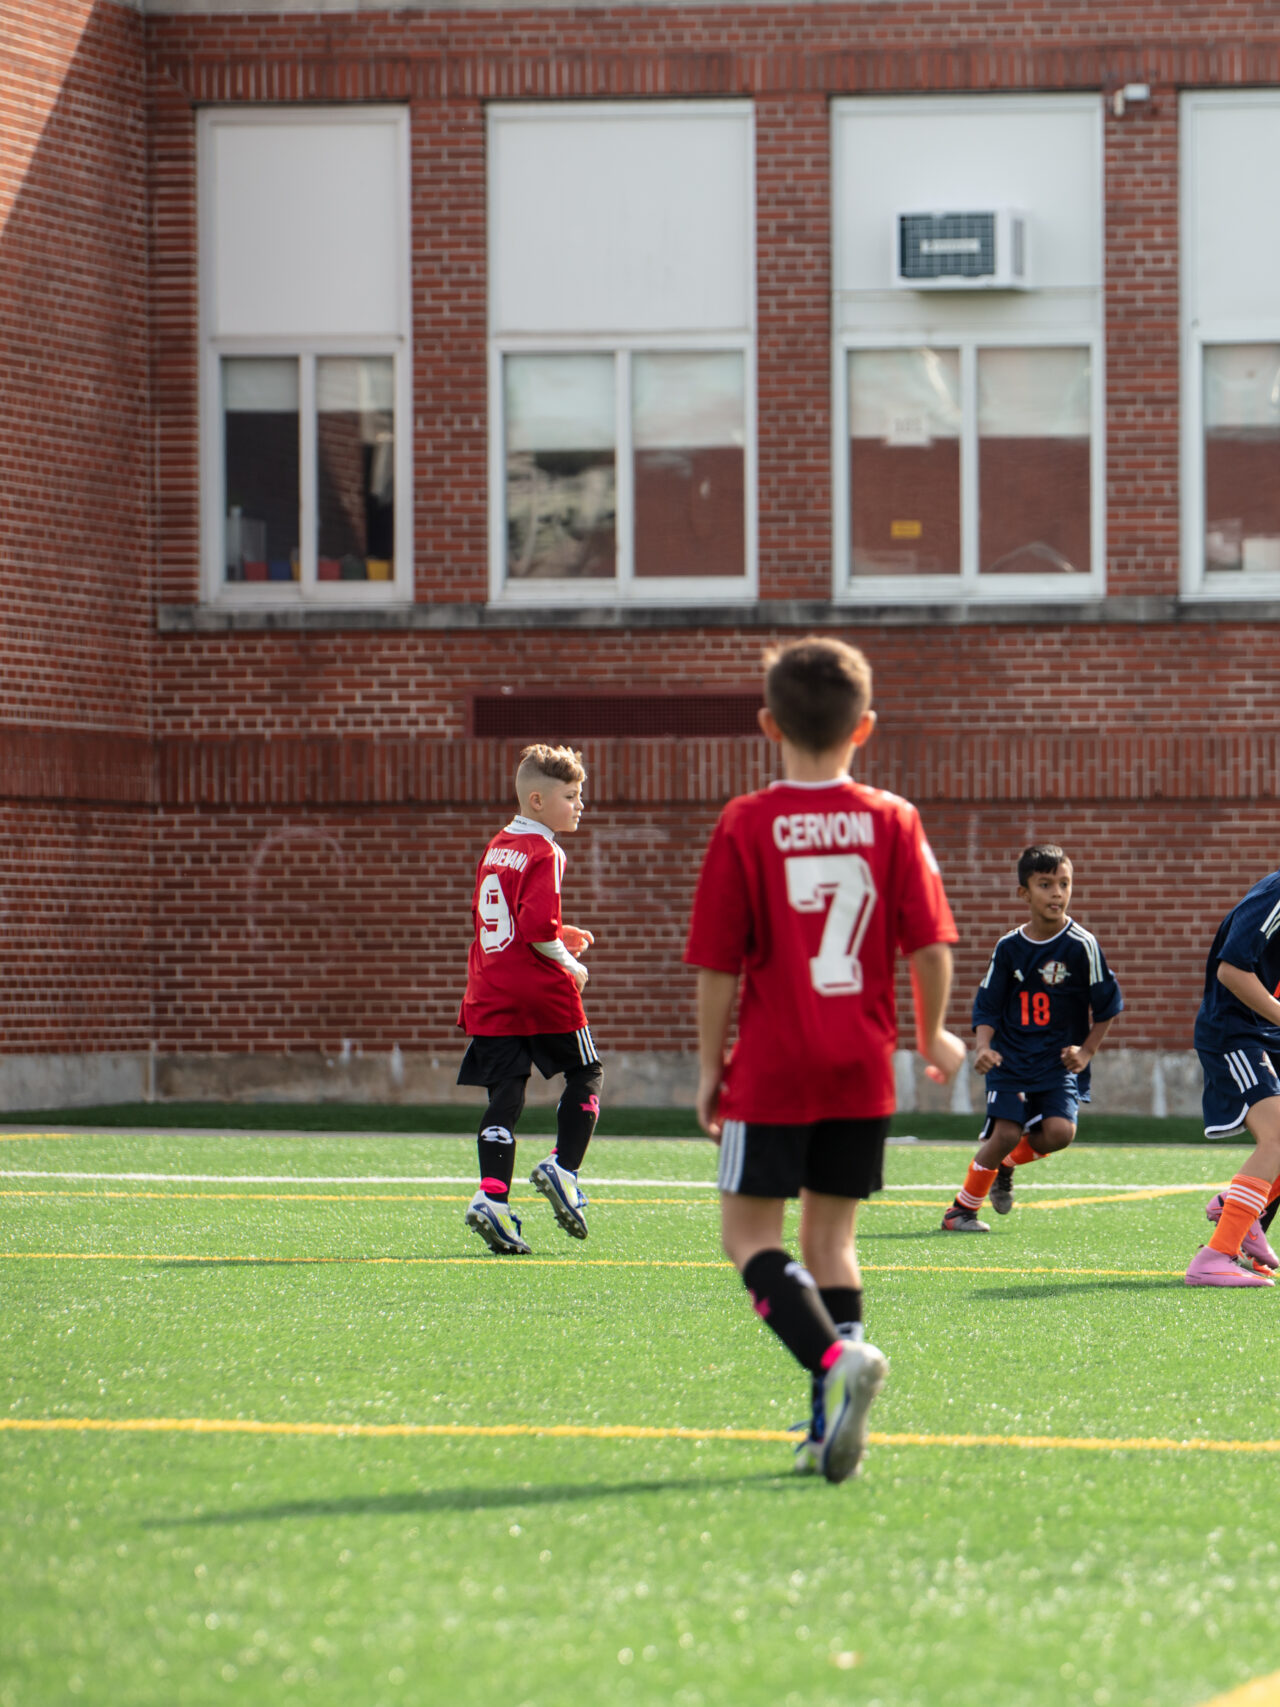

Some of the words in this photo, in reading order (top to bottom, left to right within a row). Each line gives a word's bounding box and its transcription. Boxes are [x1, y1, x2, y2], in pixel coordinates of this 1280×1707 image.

[773, 812, 874, 850] CERVONI
[478, 873, 515, 954] 9
[784, 853, 876, 996] 7
[1019, 991, 1050, 1026] 18
